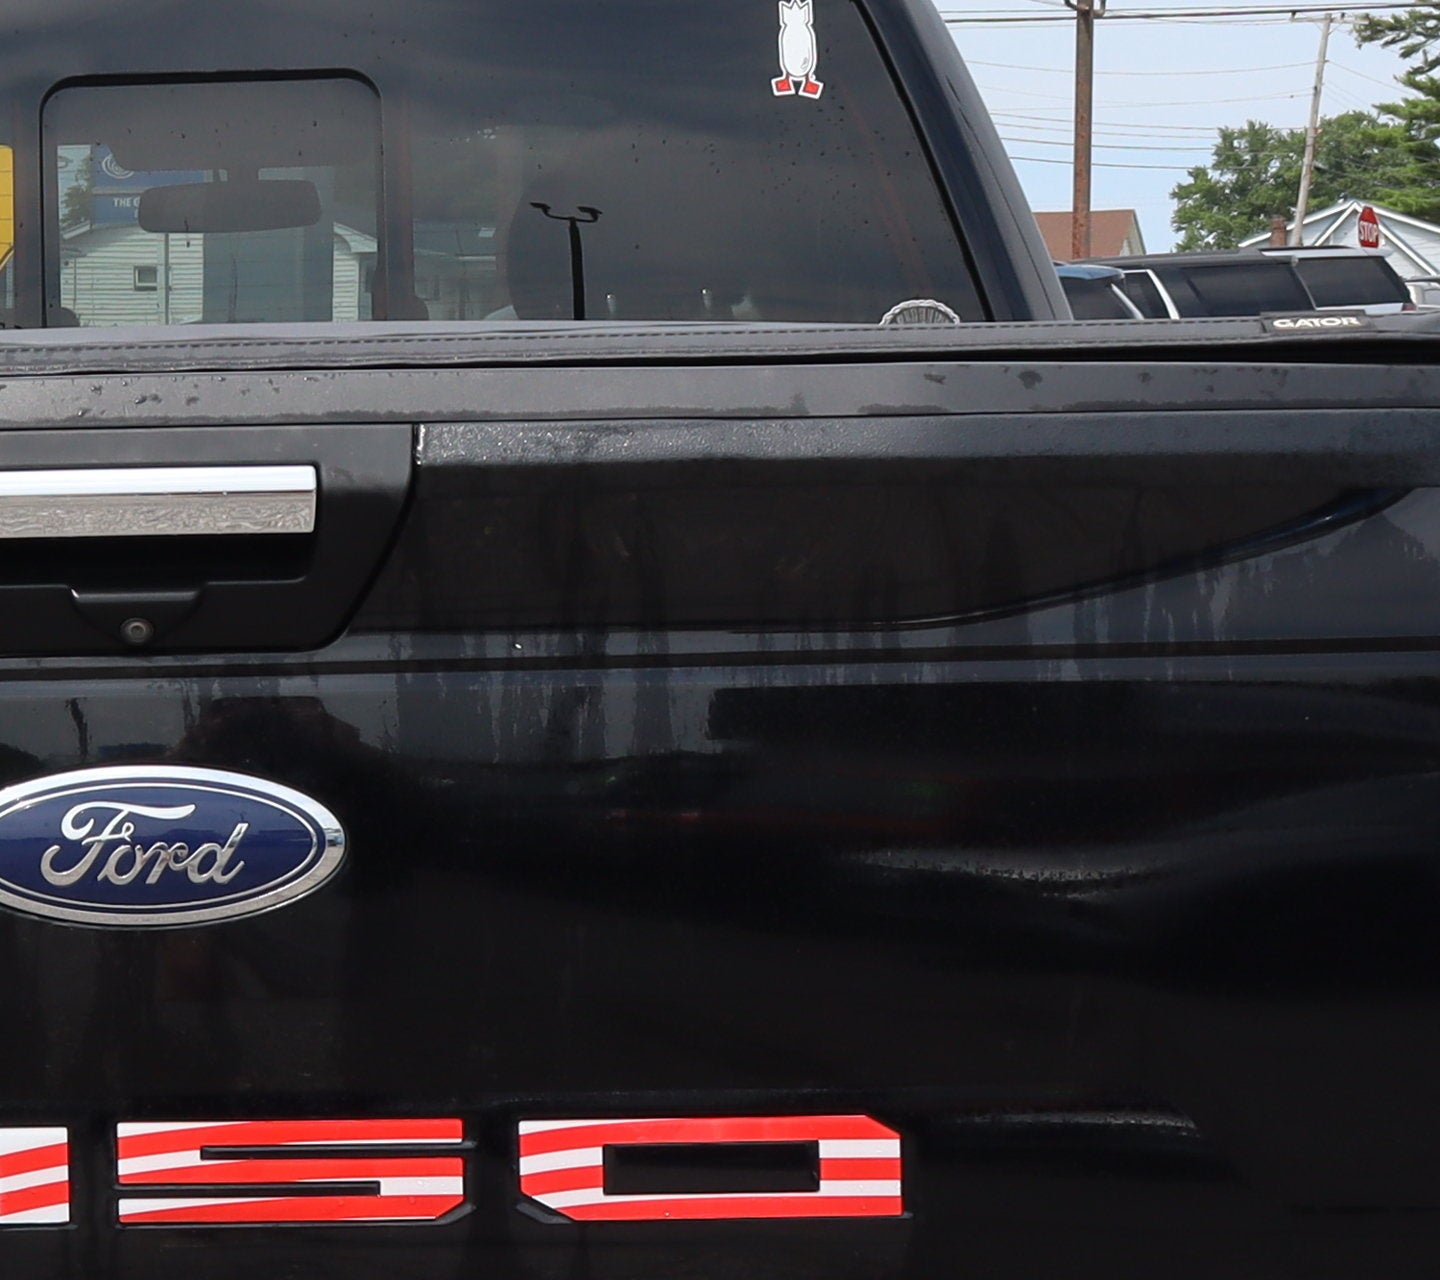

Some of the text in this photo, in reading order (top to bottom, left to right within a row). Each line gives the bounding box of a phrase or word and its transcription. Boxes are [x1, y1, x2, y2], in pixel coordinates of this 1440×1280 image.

[1360, 220, 1378, 242] STOP
[1273, 316, 1361, 329] GATOR
[40, 801, 249, 887] Ford
